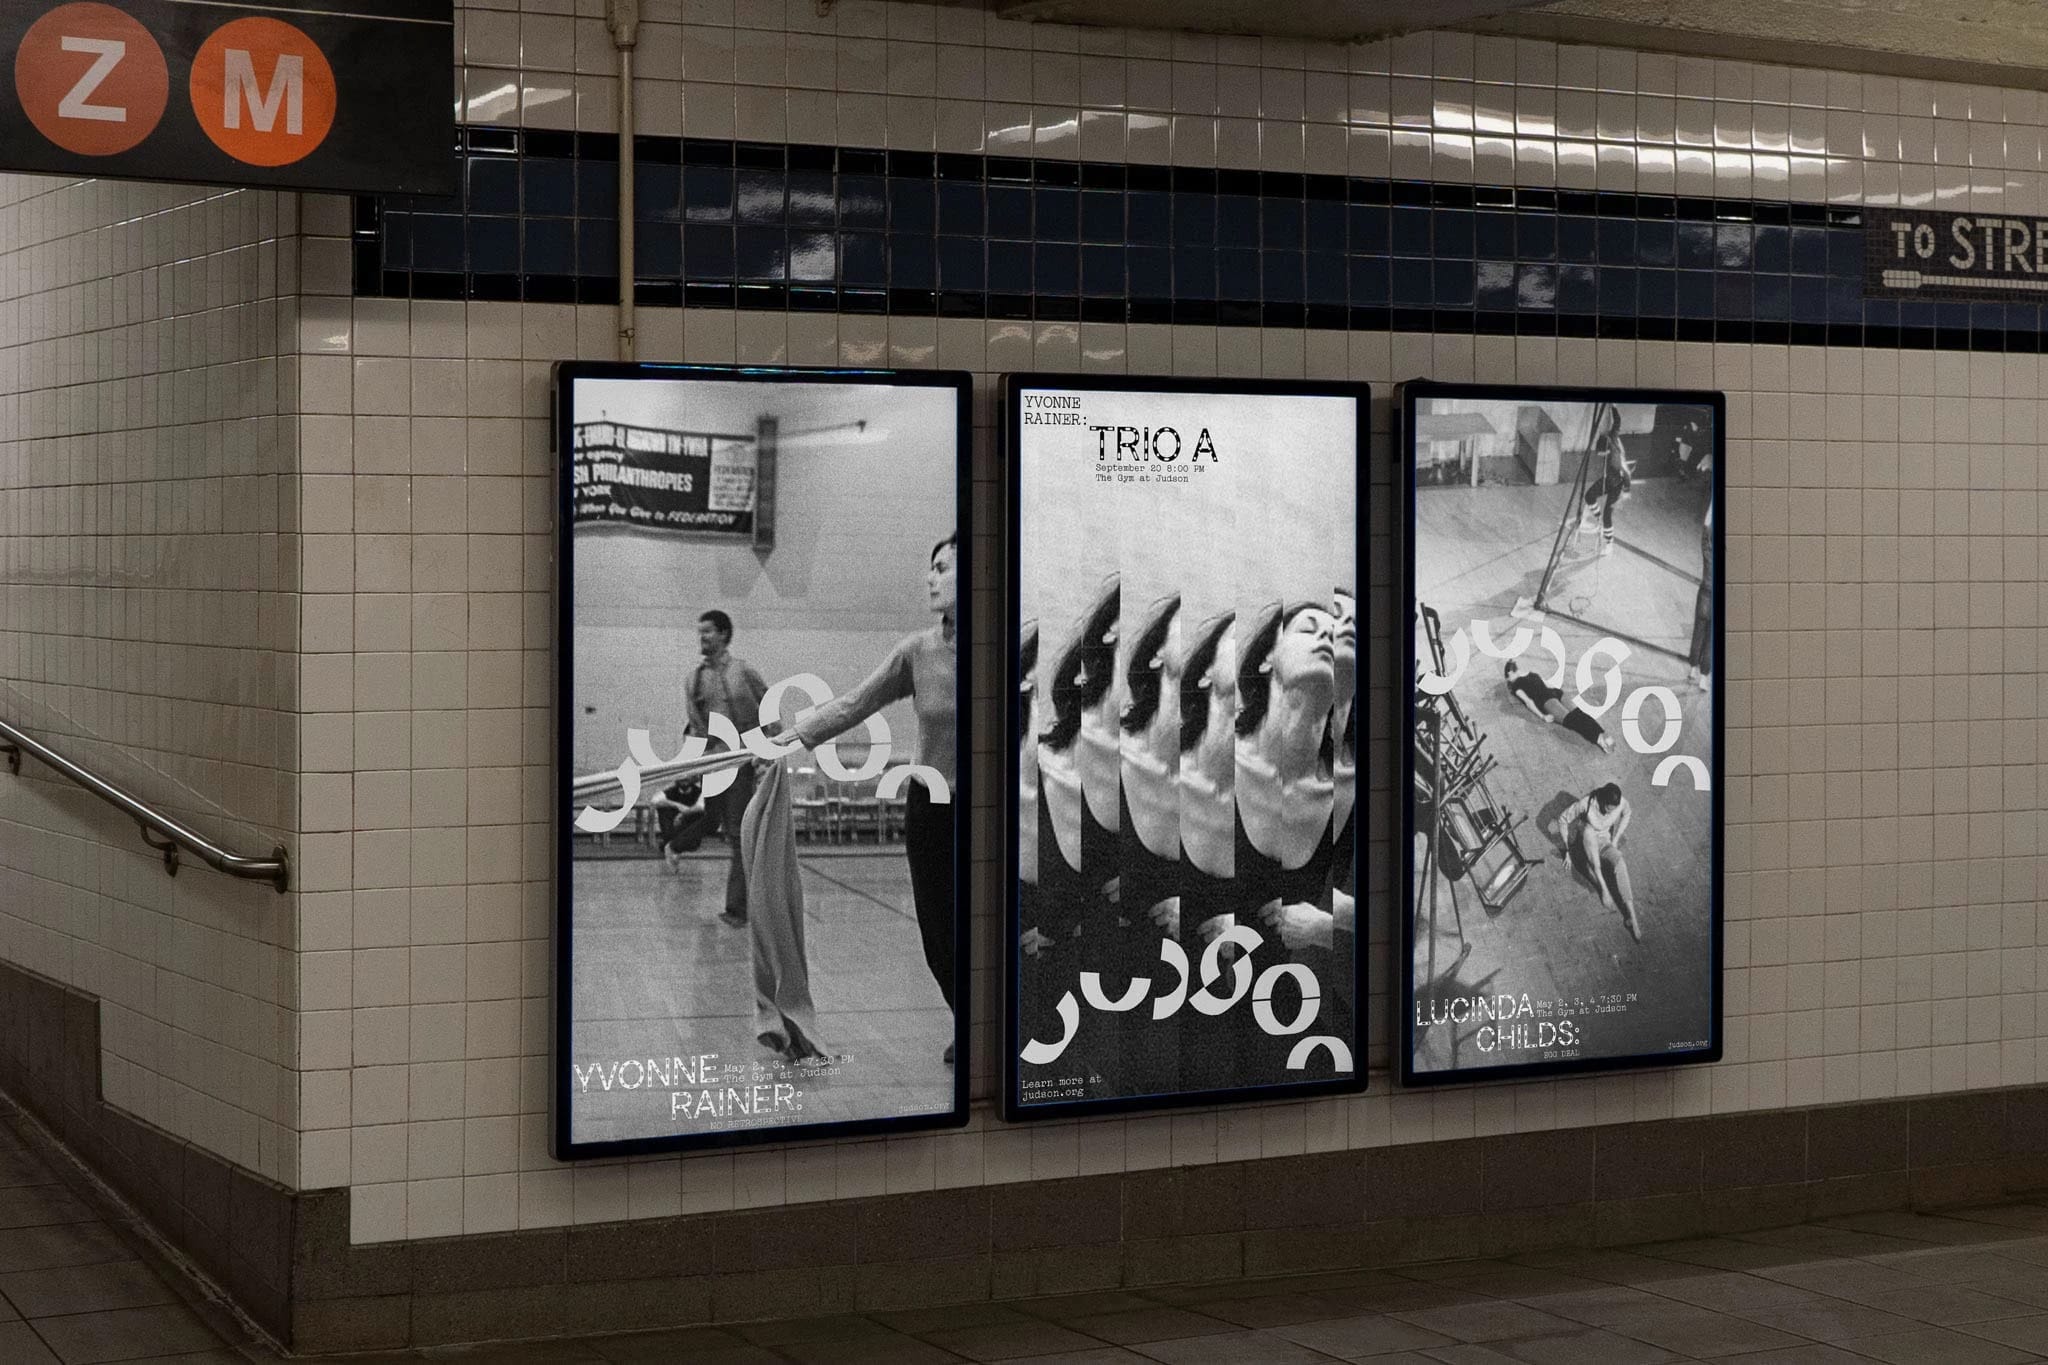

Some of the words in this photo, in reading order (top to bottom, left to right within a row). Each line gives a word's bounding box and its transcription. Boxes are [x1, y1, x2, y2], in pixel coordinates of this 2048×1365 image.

[58, 36, 126, 122] Z
[224, 48, 304, 135] M
[1891, 222, 1935, 258] TO
[1950, 217, 2048, 274] STRE
[1024, 395, 1081, 409] YVONNE
[1024, 412, 1088, 426] RAINER:
[1089, 425, 1182, 462] TRIO
[1192, 428, 1219, 462] A
[592, 462, 693, 492] PHILANTHROPIES
[1095, 463, 1146, 474] September
[1150, 464, 1162, 473] 20
[1166, 464, 1189, 473] 8:00
[1194, 465, 1205, 473] PM
[1095, 473, 1112, 482] The
[1117, 474, 1135, 483] Gym
[1140, 474, 1151, 482] at
[1155, 474, 1189, 483] Judson
[1416, 993, 1535, 1026] LUCINDA
[1536, 1000, 1553, 1009] May
[1600, 994, 1622, 1004] 7:30
[1626, 993, 1638, 1002] PM
[1536, 1009, 1553, 1018] The
[1557, 1008, 1575, 1018] Gym
[1579, 1006, 1591, 1015] at
[1595, 1004, 1627, 1014] Judson
[1476, 1020, 1581, 1052] CHILDS:
[574, 1054, 719, 1093] YVONNE
[724, 1063, 745, 1074] May
[772, 1059, 786, 1070] 3,
[794, 1058, 801, 1067] 4
[807, 1055, 835, 1067] 7:30
[841, 1054, 855, 1064] PM
[724, 1072, 745, 1083] The
[752, 1071, 773, 1082] Gym
[779, 1069, 793, 1079] at
[800, 1067, 841, 1079] Judson
[1022, 1080, 1053, 1089] Learn
[1059, 1077, 1084, 1086] more
[1089, 1074, 1102, 1084] at
[672, 1083, 803, 1120] RAINER:
[1022, 1088, 1084, 1101] judson.org
